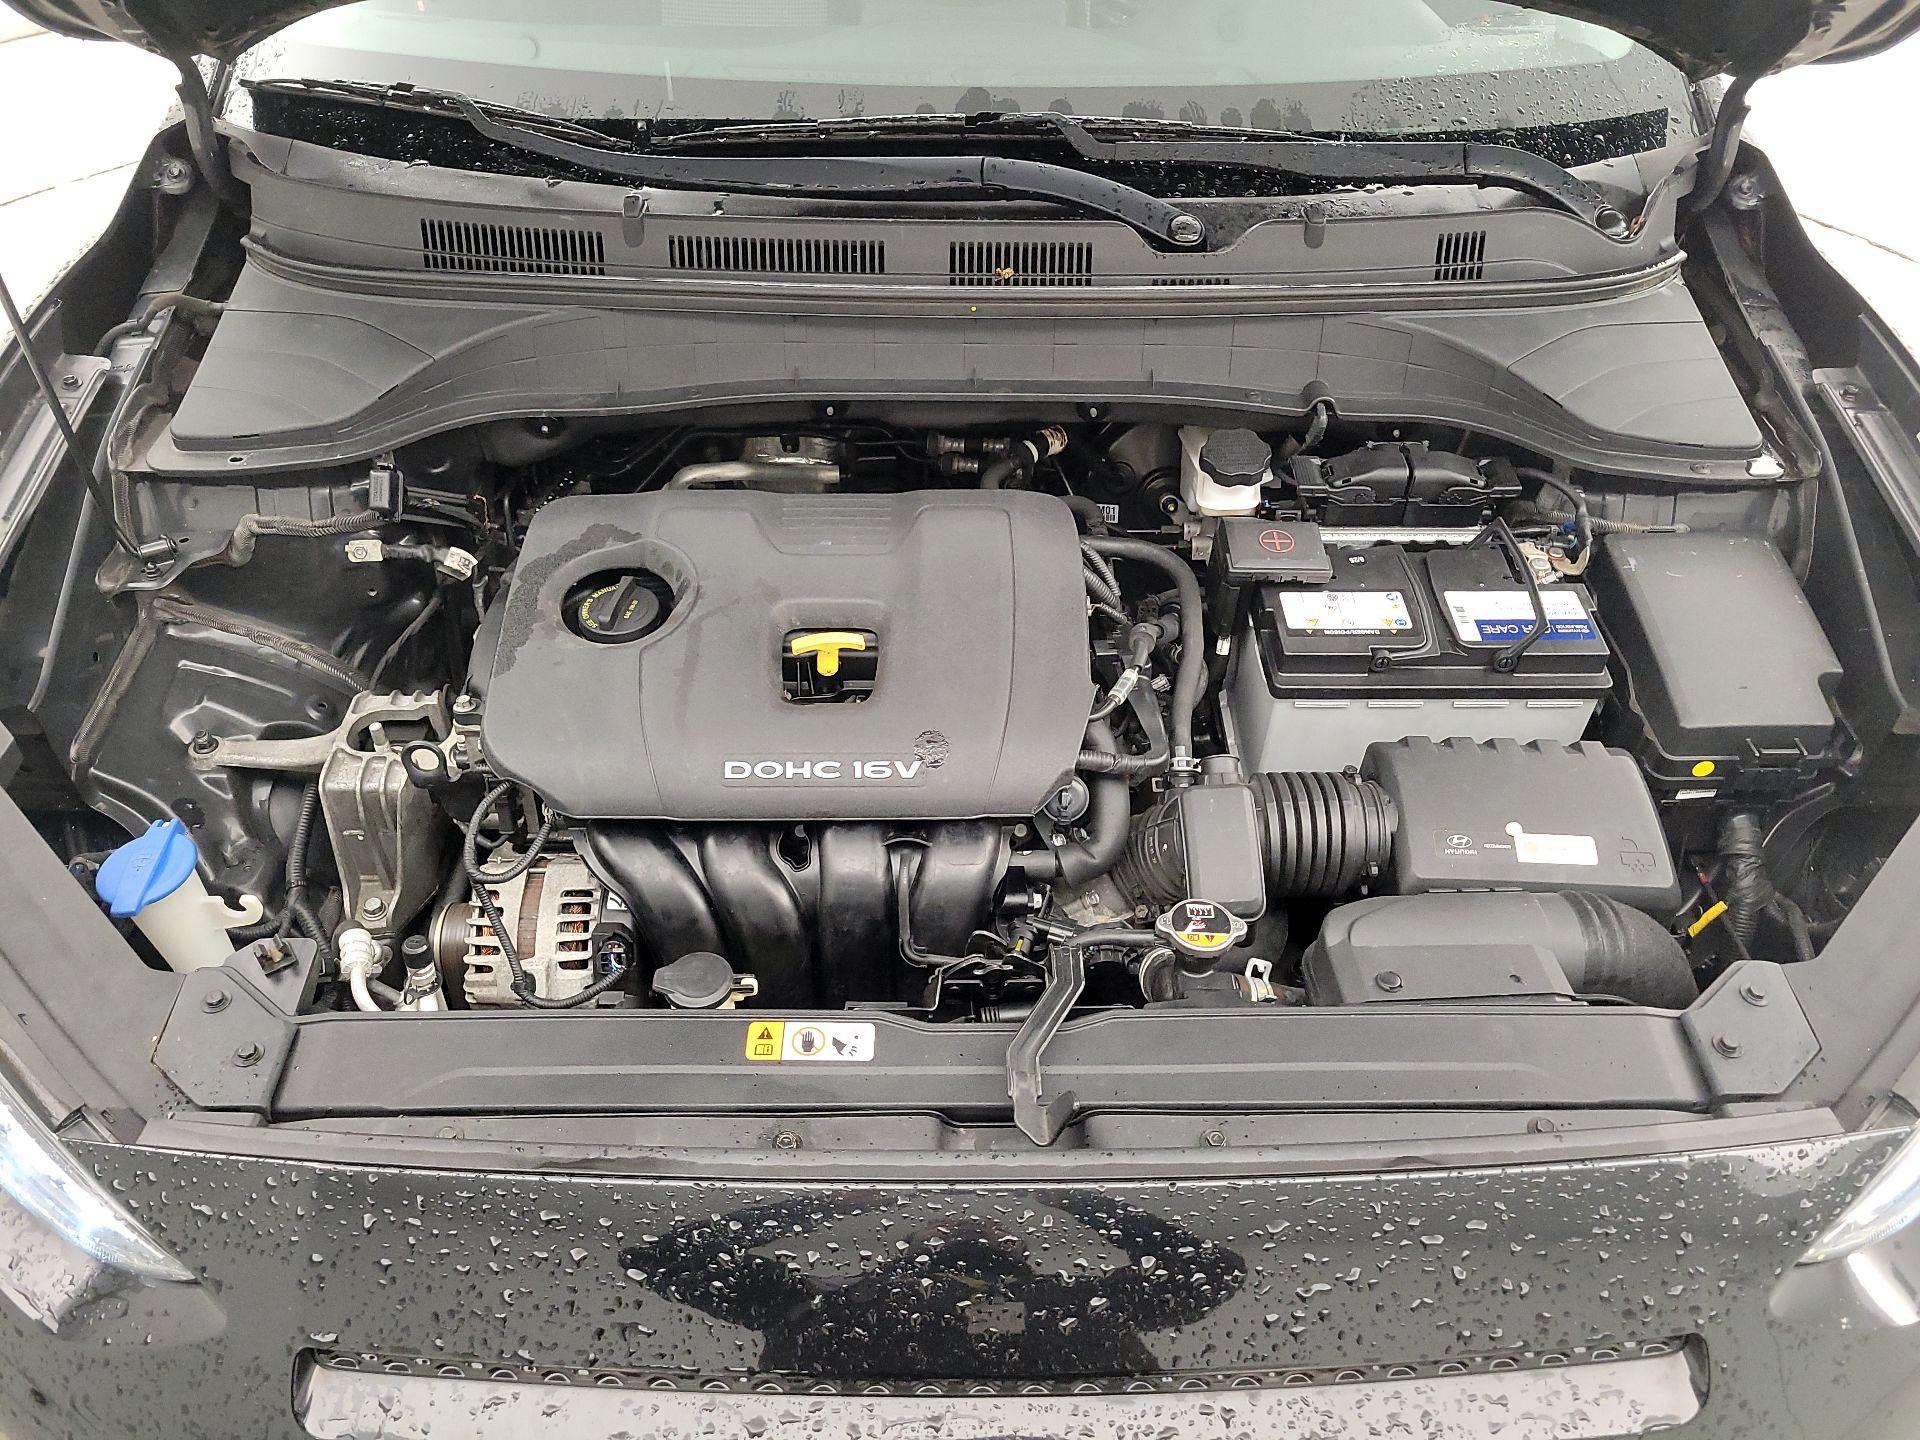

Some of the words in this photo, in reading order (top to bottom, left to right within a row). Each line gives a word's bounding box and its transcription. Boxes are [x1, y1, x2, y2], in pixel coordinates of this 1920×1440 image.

[1481, 624, 1519, 634] CARE
[724, 761, 842, 779] DOHC
[853, 761, 923, 779] 16V
[1444, 848, 1478, 856] HYUNDAI
